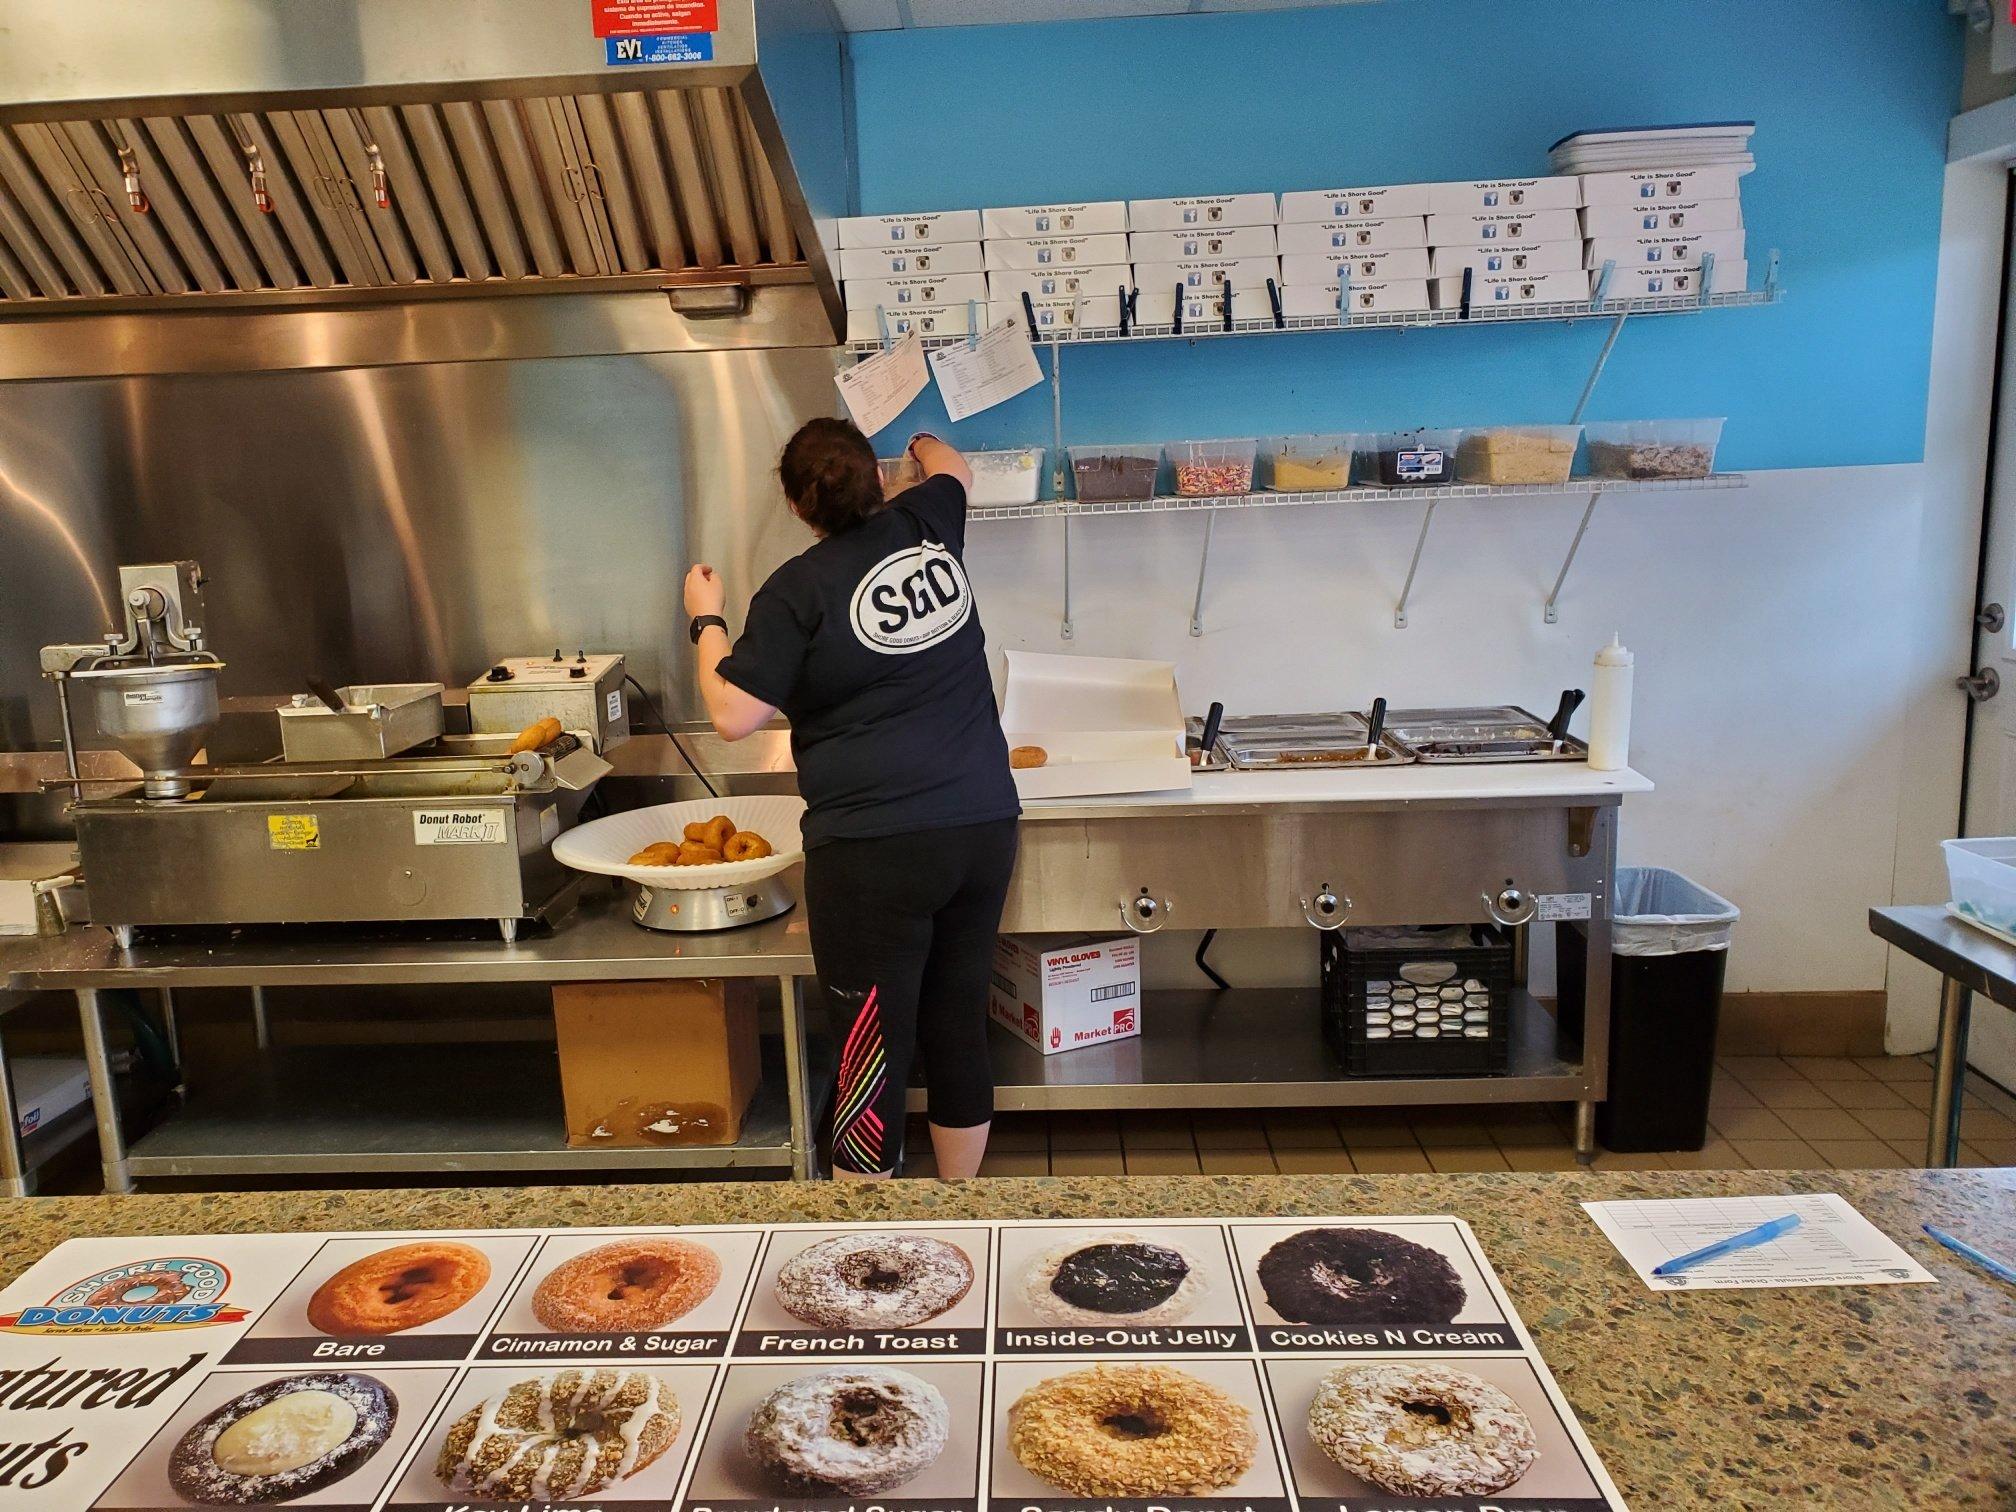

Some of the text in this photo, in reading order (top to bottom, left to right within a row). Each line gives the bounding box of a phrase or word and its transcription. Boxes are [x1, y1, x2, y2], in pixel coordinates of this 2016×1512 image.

[616, 39, 642, 60] EVI
[420, 814, 482, 824] Donut Robot
[437, 825, 480, 839] MARK
[1047, 956, 1070, 966] VINYL
[1071, 950, 1101, 962] GLOVES
[1074, 1022, 1134, 1041] Market PRO
[61, 1261, 219, 1304] SHORE GOOD
[14, 1303, 228, 1326] DONUTS
[491, 1336, 718, 1354] Cinnamon & Sugar
[760, 1333, 959, 1350] French Toast
[1006, 1330, 1237, 1348] Inside-Out Jelly
[1271, 1330, 1504, 1347] Cookies N Cream
[312, 1341, 386, 1357] Bare
